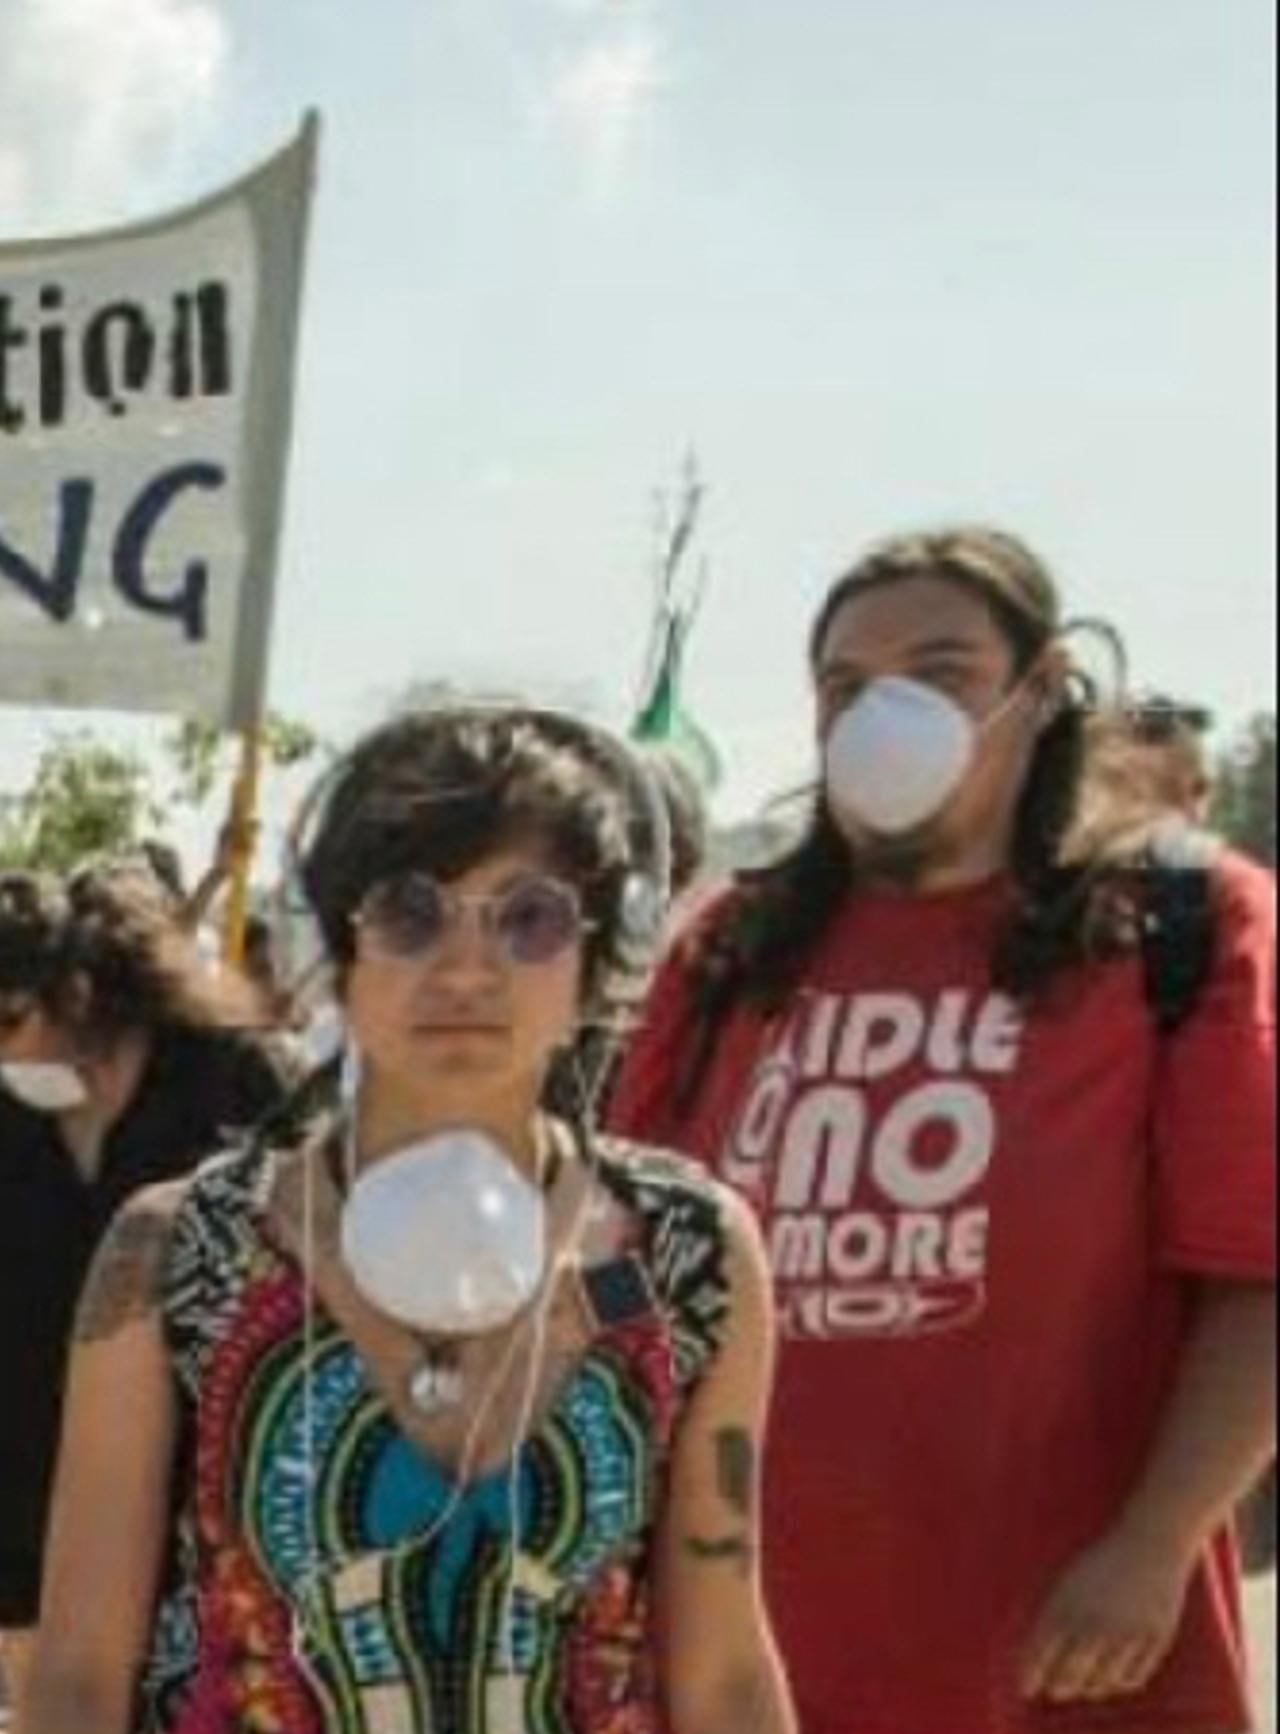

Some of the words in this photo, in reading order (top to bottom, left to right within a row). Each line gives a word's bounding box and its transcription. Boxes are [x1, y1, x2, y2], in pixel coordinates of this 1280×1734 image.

[800, 988, 1027, 1080] IDLE
[772, 1078, 998, 1211] NO
[771, 1206, 991, 1280] MORE
